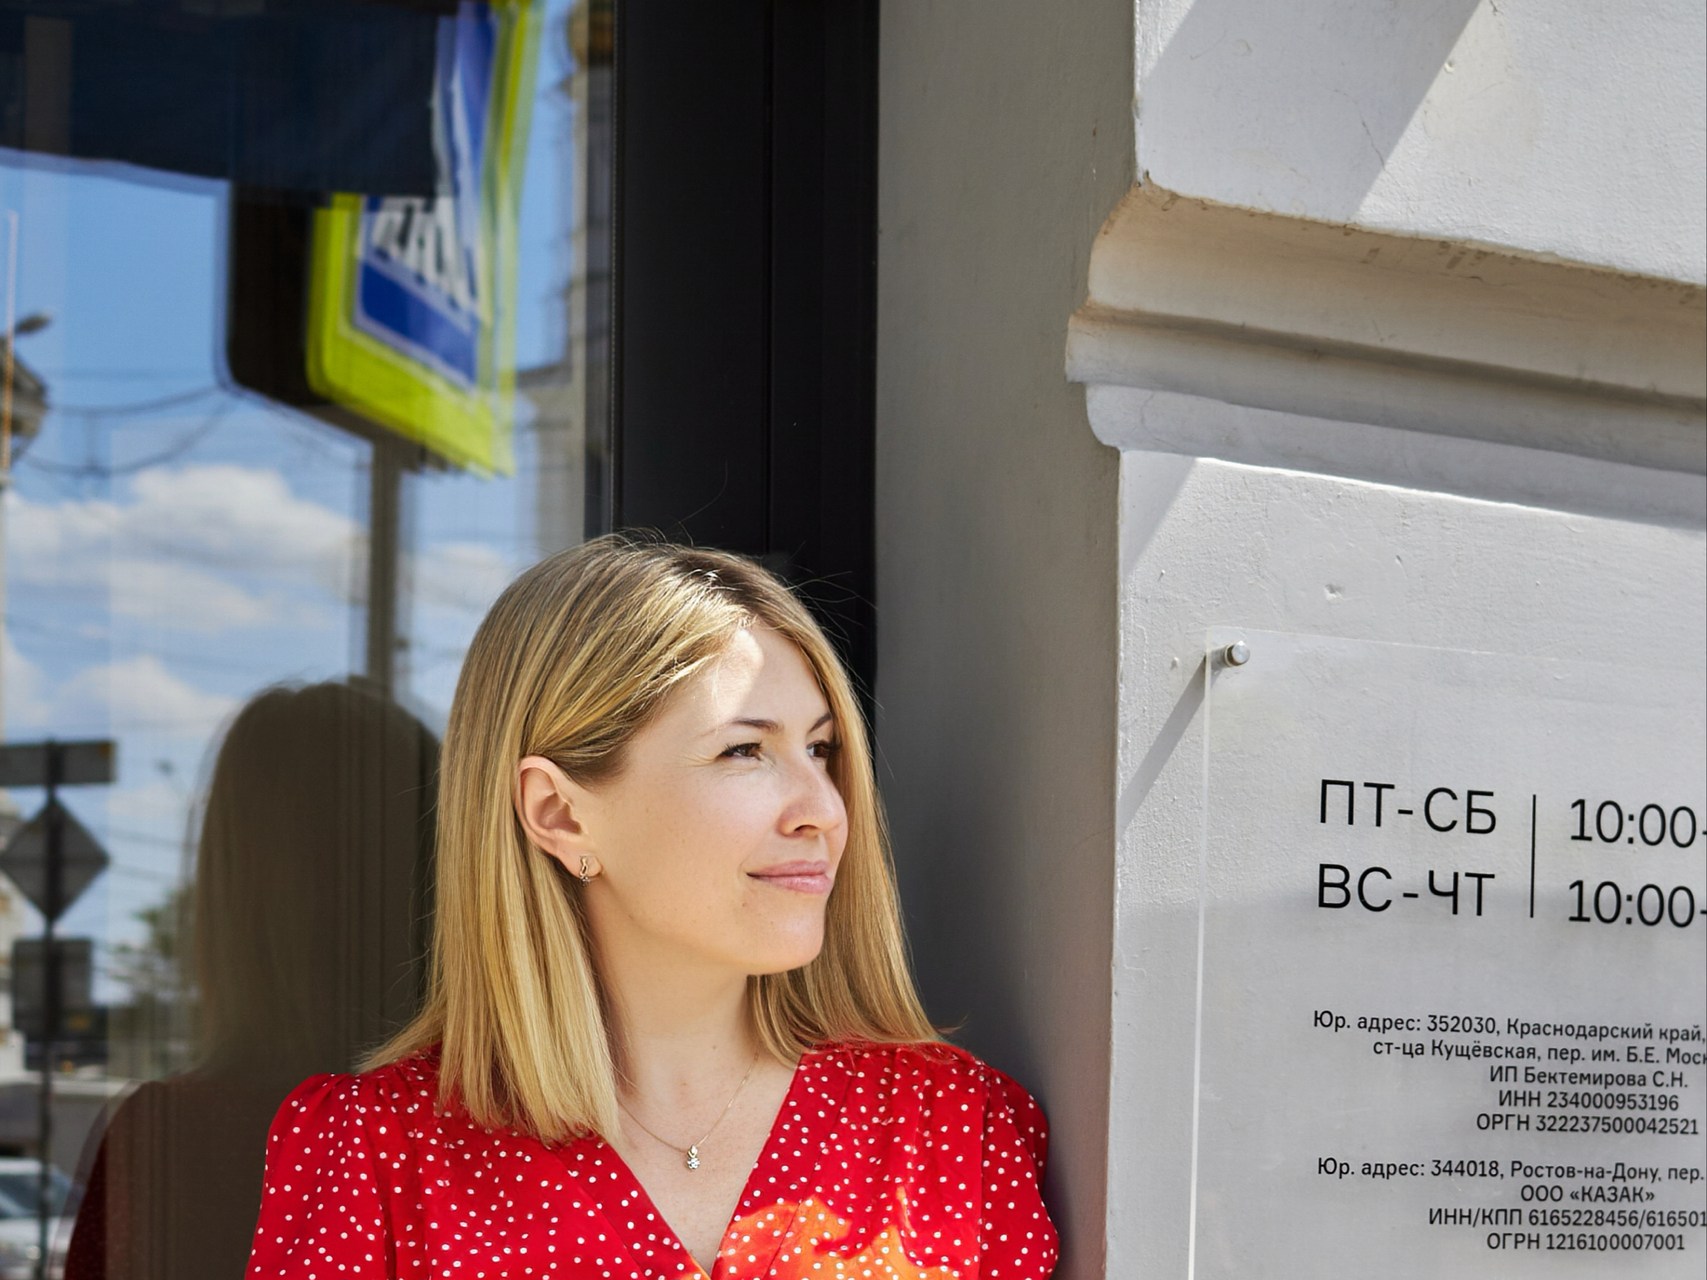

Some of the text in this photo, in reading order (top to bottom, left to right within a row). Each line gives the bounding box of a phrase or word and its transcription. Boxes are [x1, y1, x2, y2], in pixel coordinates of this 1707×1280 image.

[1320, 779, 1496, 834] ПТ-СБ
[1318, 863, 1496, 916] ВС-ЧТ
[1313, 1010, 1706, 1045] Юр. адрес: 352030, Краснодарский край,
[1372, 1040, 1426, 1059] ст-ца
[1431, 1038, 1541, 1063] Кущёвская,
[1547, 1047, 1586, 1066] пер.
[1591, 1048, 1620, 1063] им.
[1626, 1045, 1660, 1064] Б.Е.
[1489, 1065, 1689, 1091] ИП Бектемирова С.Н.
[1498, 1089, 1680, 1111] ИНН 234000953196
[1476, 1112, 1700, 1136] ОРГН 322237500042521
[1317, 1157, 1356, 1180] Юр.
[1360, 1162, 1425, 1180] адрес:
[1430, 1159, 1504, 1180] 344018,
[1667, 1167, 1705, 1185] пер.
[1520, 1184, 1656, 1204] ООО «КАЗАК»
[1428, 1207, 1523, 1229] ИНН/КПП
[1486, 1232, 1686, 1252] ОГРН 1216100007001
